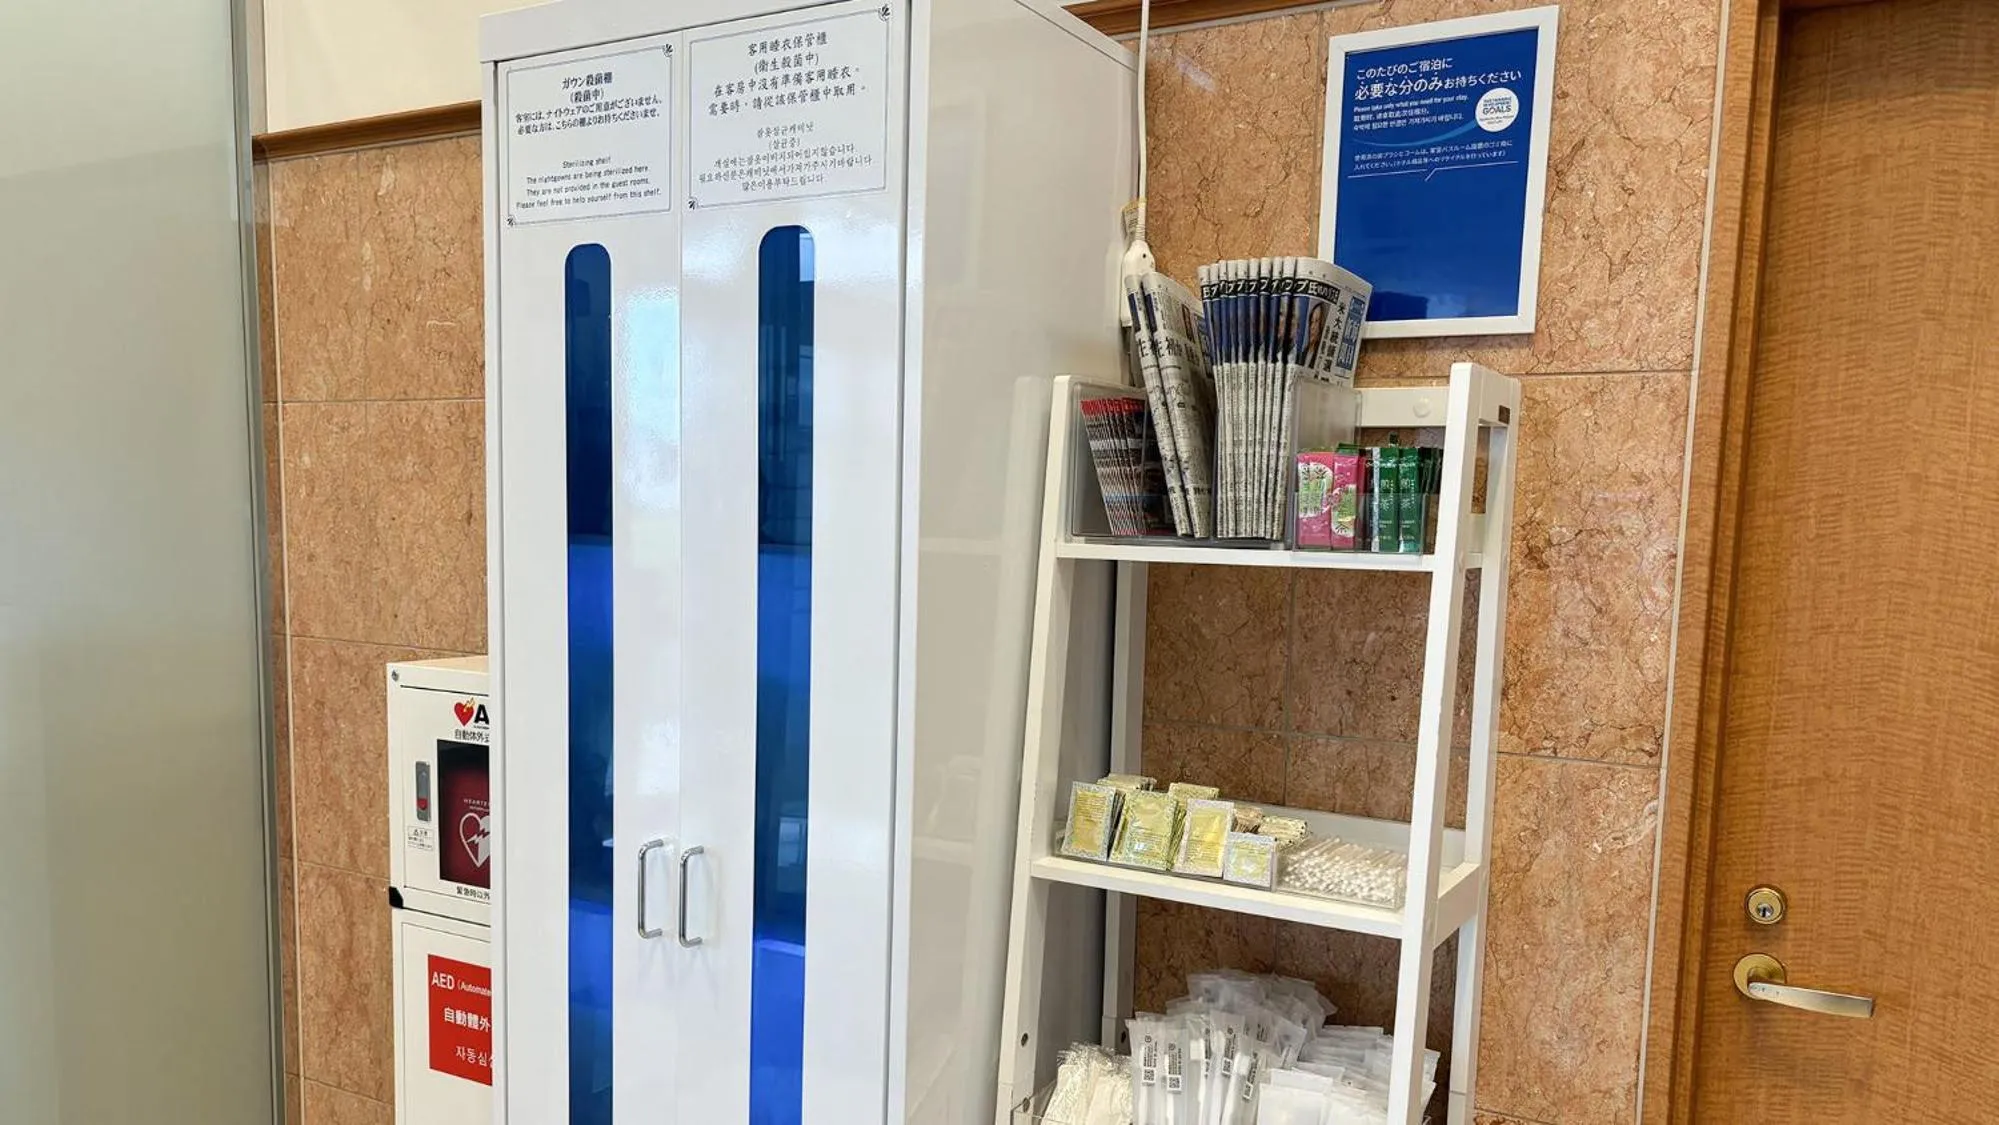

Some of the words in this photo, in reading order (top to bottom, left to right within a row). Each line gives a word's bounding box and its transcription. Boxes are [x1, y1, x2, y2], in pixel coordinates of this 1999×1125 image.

[748, 31, 828, 57] 客用睡衣保管櫃
[1356, 57, 1453, 80] このたびのご宿泊に
[561, 71, 613, 90] ガウン殺菌棚
[1354, 70, 1522, 101] 必要な分のみお持ちください
[1482, 104, 1512, 115] GOALS
[562, 159, 594, 169] Sterilizing
[595, 156, 611, 166] shelf
[526, 177, 537, 185] The
[538, 174, 571, 184] nightgowns
[573, 172, 583, 180] are
[584, 170, 602, 179] being
[603, 167, 632, 178] sterilized
[526, 189, 540, 198] They
[541, 187, 552, 196] are
[553, 186, 563, 194] not
[564, 183, 591, 194] provided
[592, 182, 598, 190] in
[600, 181, 609, 189] the
[611, 179, 629, 189] guest
[515, 201, 535, 210] Please
[536, 199, 549, 208] feel
[550, 197, 563, 206] free
[564, 197, 571, 205] to
[572, 195, 586, 204] help
[587, 192, 611, 203] yourself
[613, 191, 628, 199] from
[629, 190, 642, 199] this
[431, 972, 455, 990] AED
[444, 1007, 490, 1032] 自動體外
